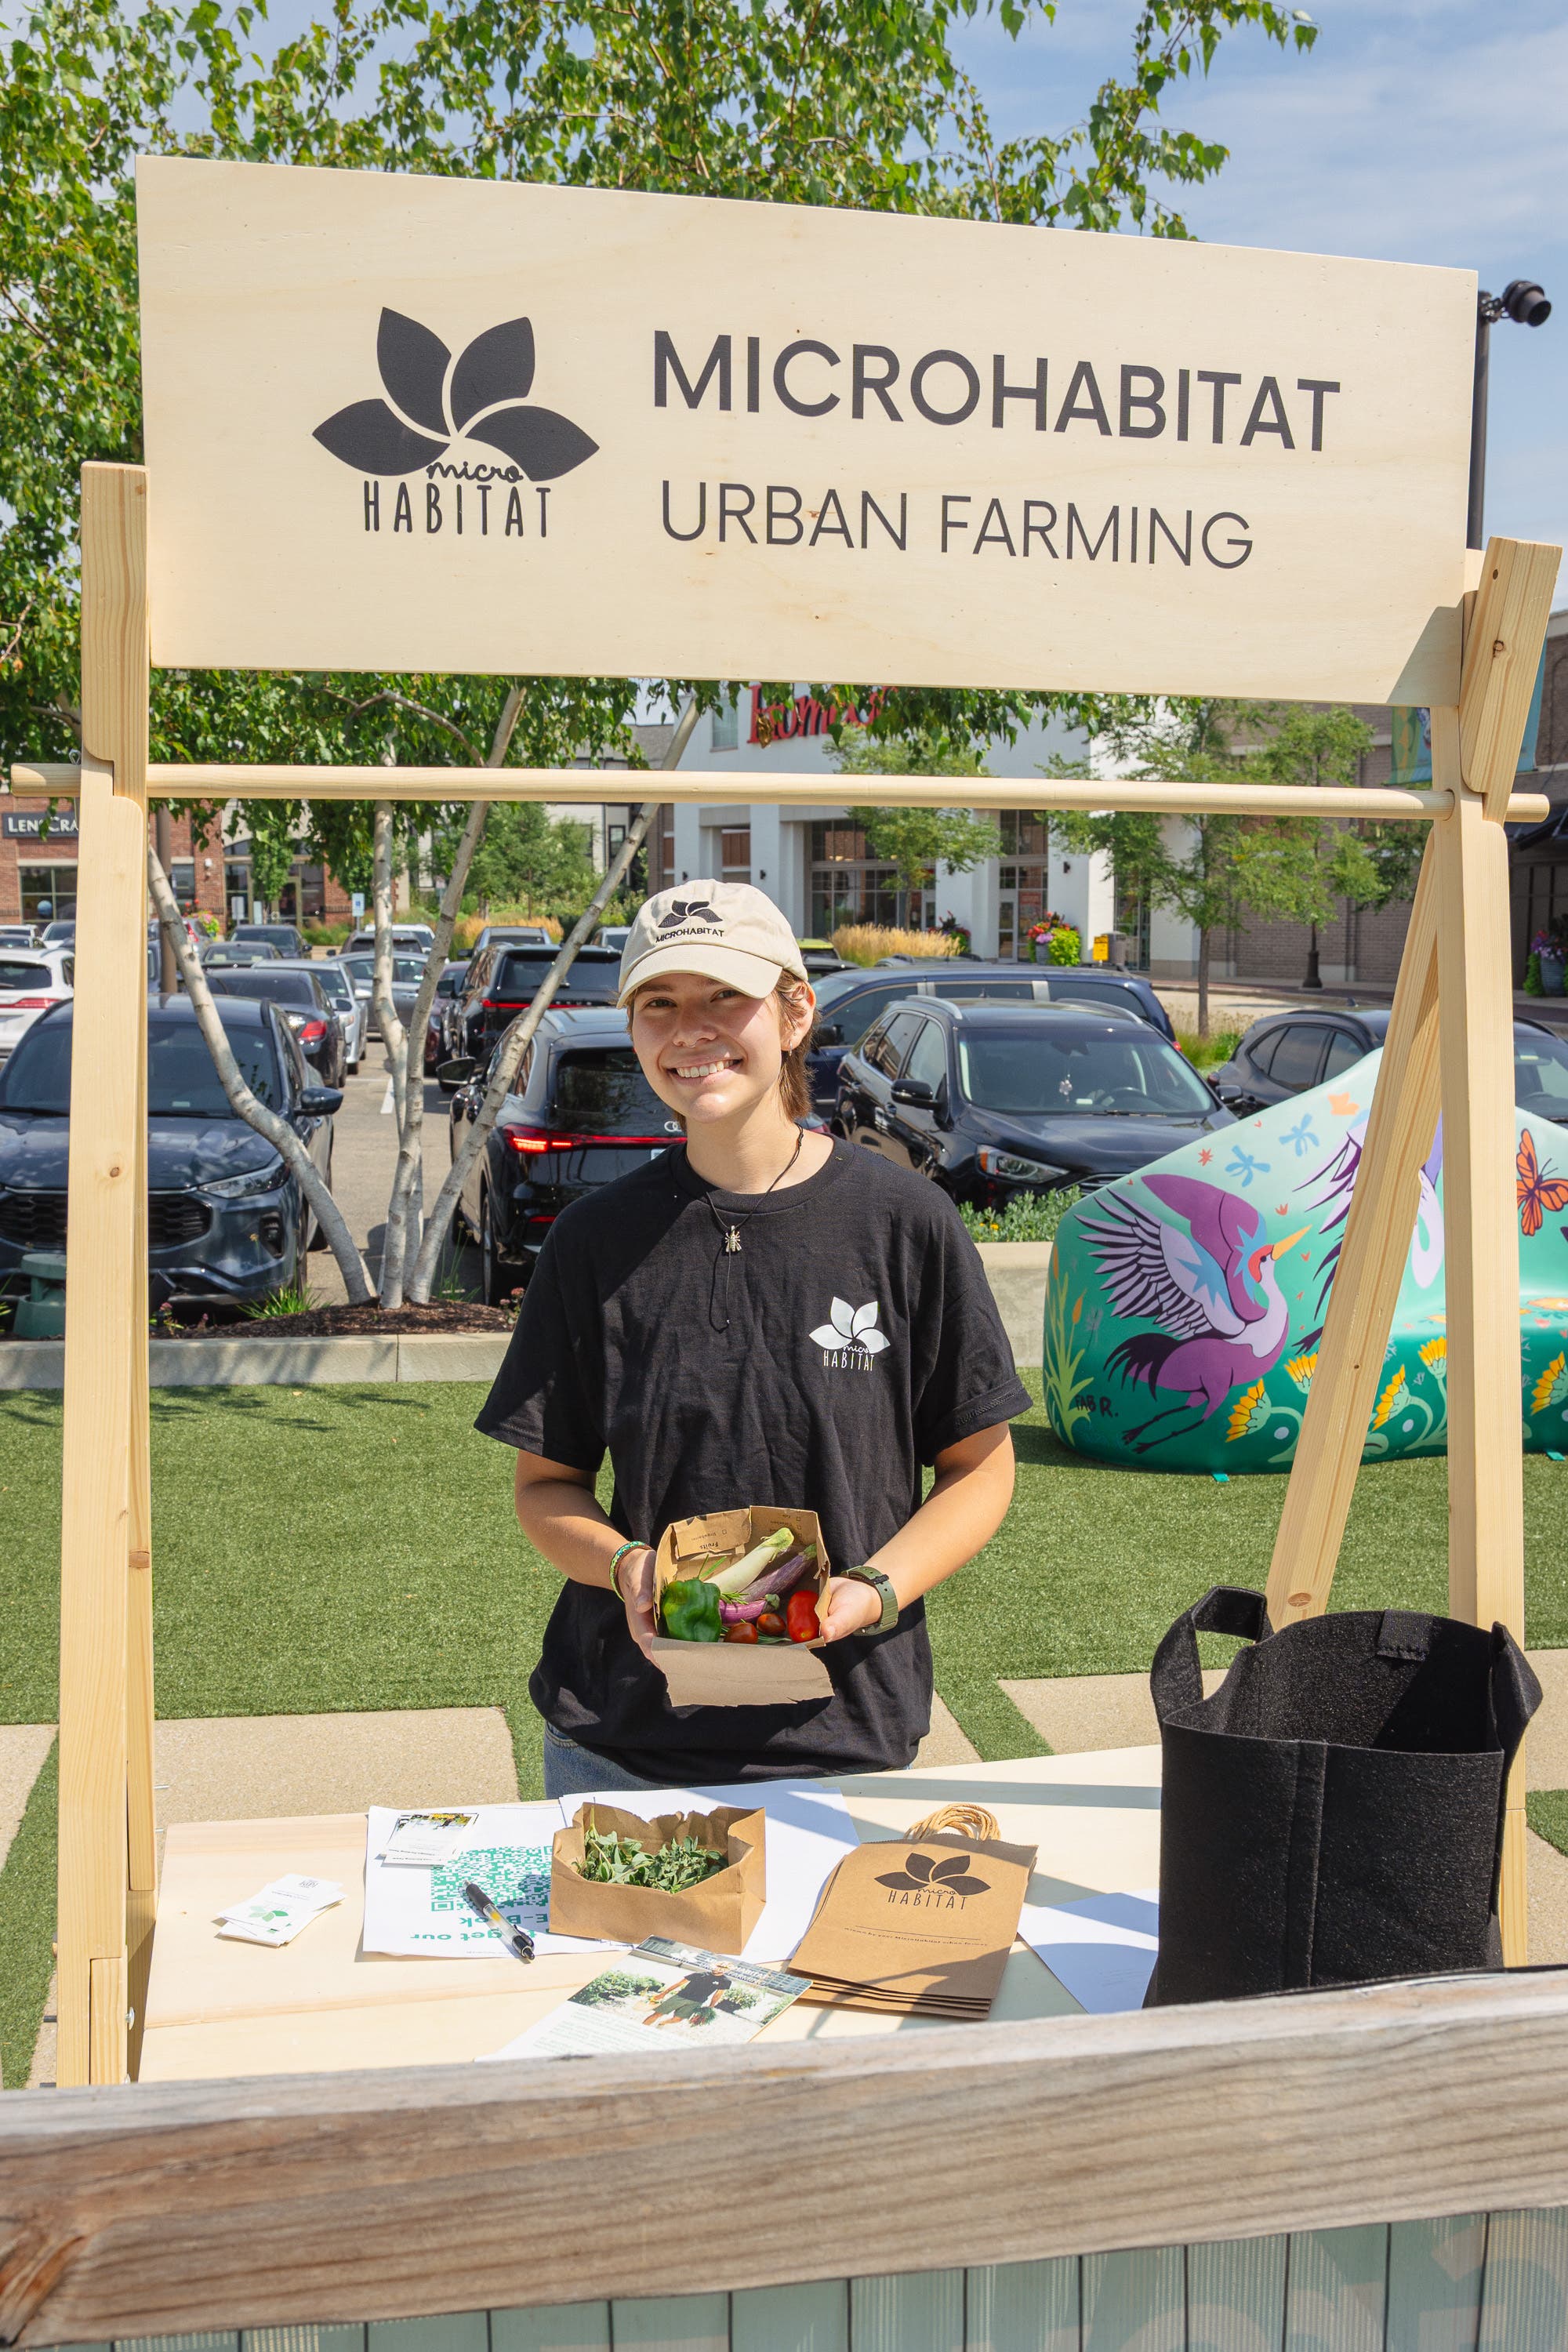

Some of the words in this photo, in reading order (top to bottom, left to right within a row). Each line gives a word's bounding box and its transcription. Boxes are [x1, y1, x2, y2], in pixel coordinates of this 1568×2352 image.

[655, 331, 1340, 451] MICROHABITAT
[426, 461, 523, 483] micro
[364, 480, 550, 537] HABITAT
[663, 481, 906, 550] URBAN
[942, 495, 1252, 568] FARMING
[655, 927, 724, 943] MICROHABITAT
[823, 1349, 875, 1372] HABITAT
[887, 1889, 968, 1911] HABITAT
[916, 1887, 957, 1896] micro
[459, 1913, 549, 1928] E-Bok
[410, 1932, 452, 1940] our
[460, 1929, 503, 1941] get
